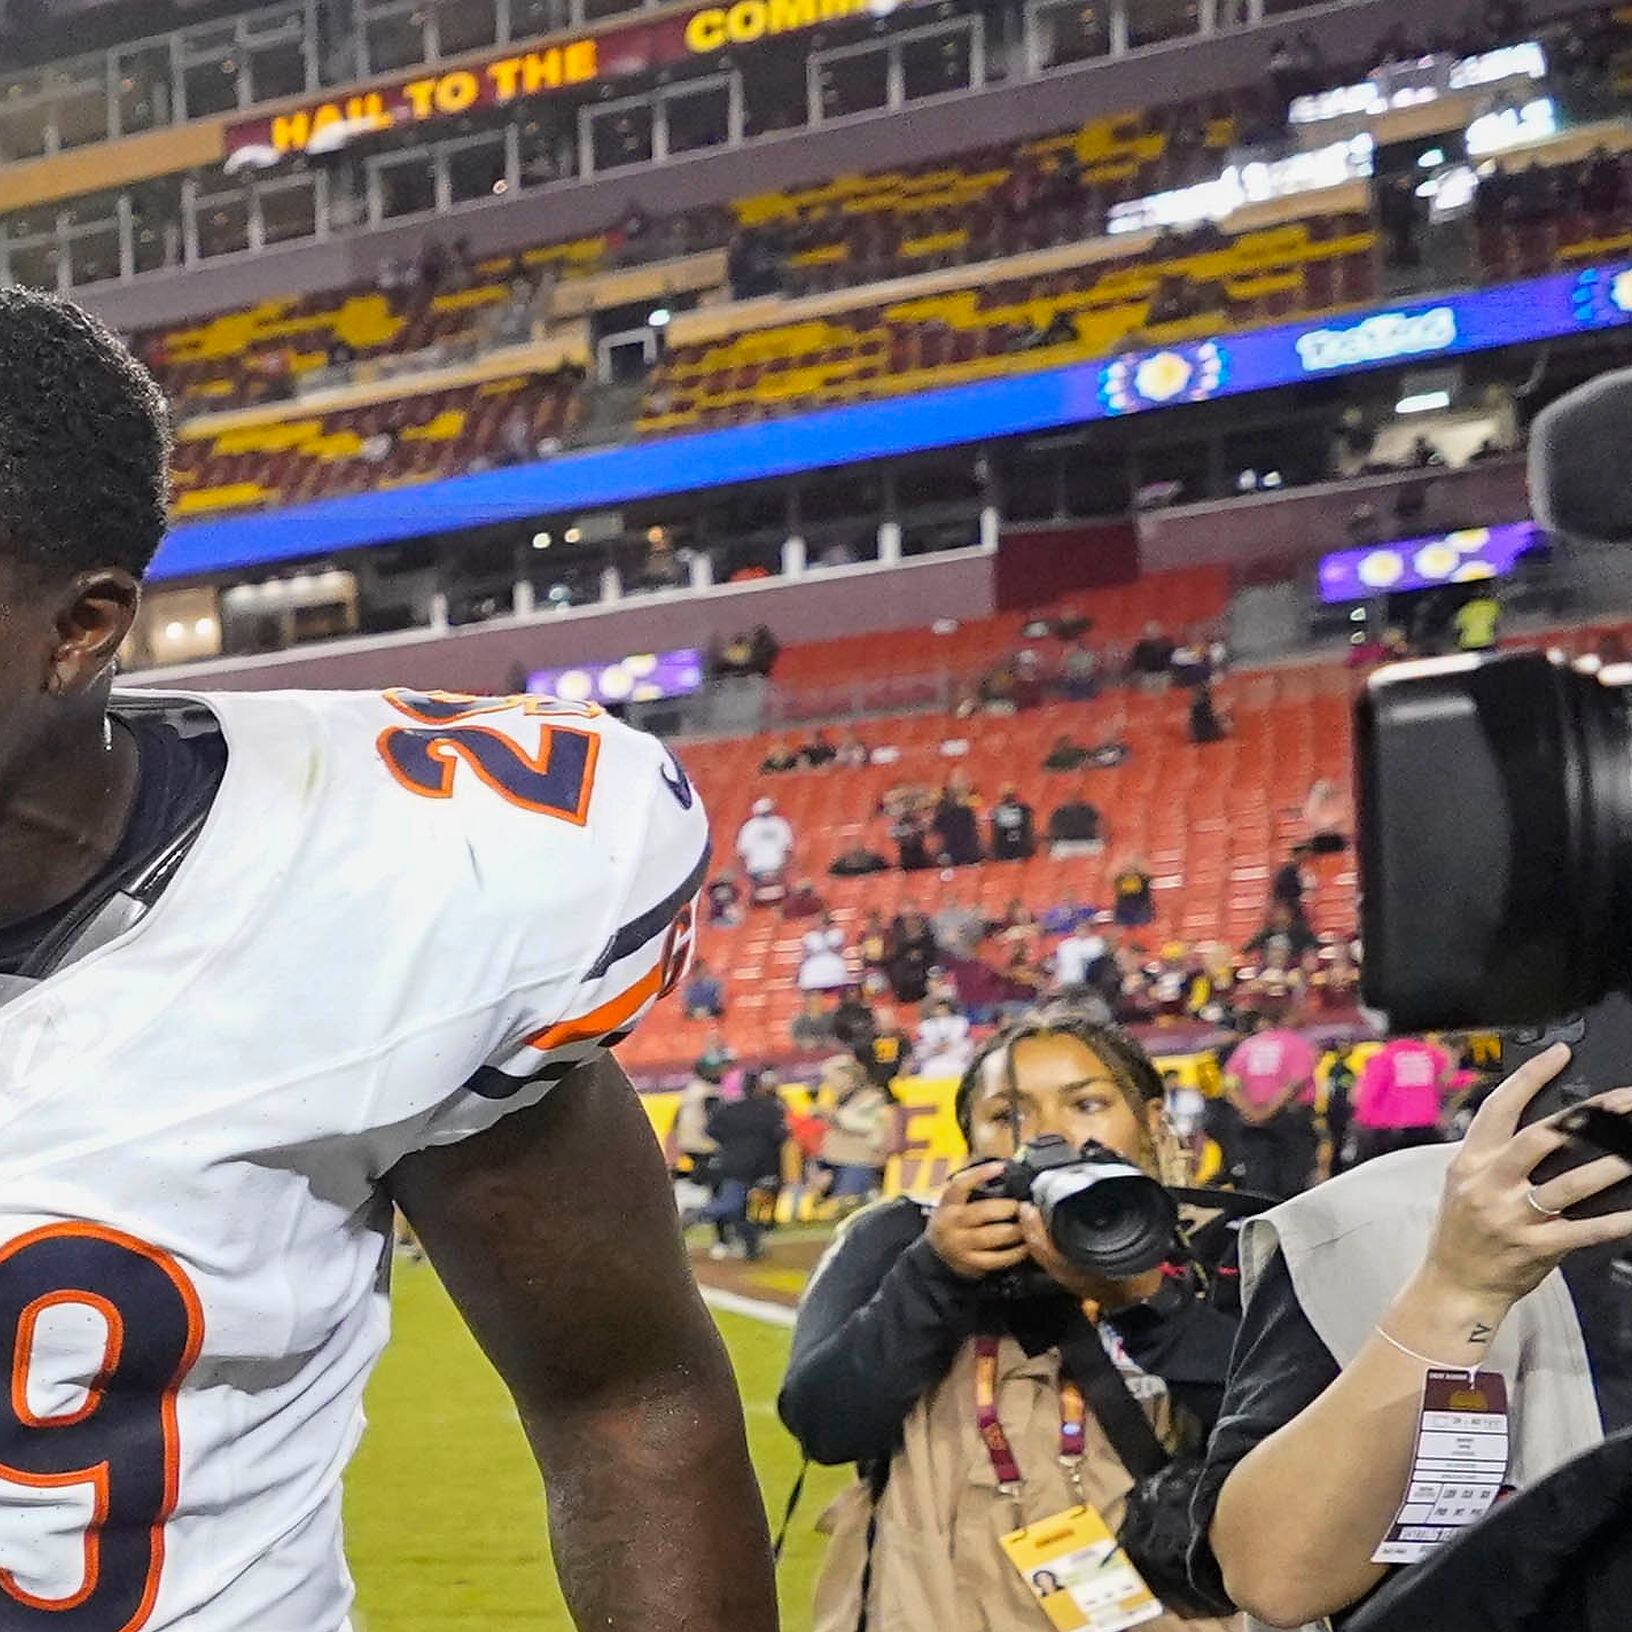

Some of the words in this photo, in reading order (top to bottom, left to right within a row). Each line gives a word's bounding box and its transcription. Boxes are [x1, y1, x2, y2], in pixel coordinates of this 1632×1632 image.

[271, 92, 392, 153] HAIL
[403, 70, 479, 120] TO
[487, 39, 598, 98] THE
